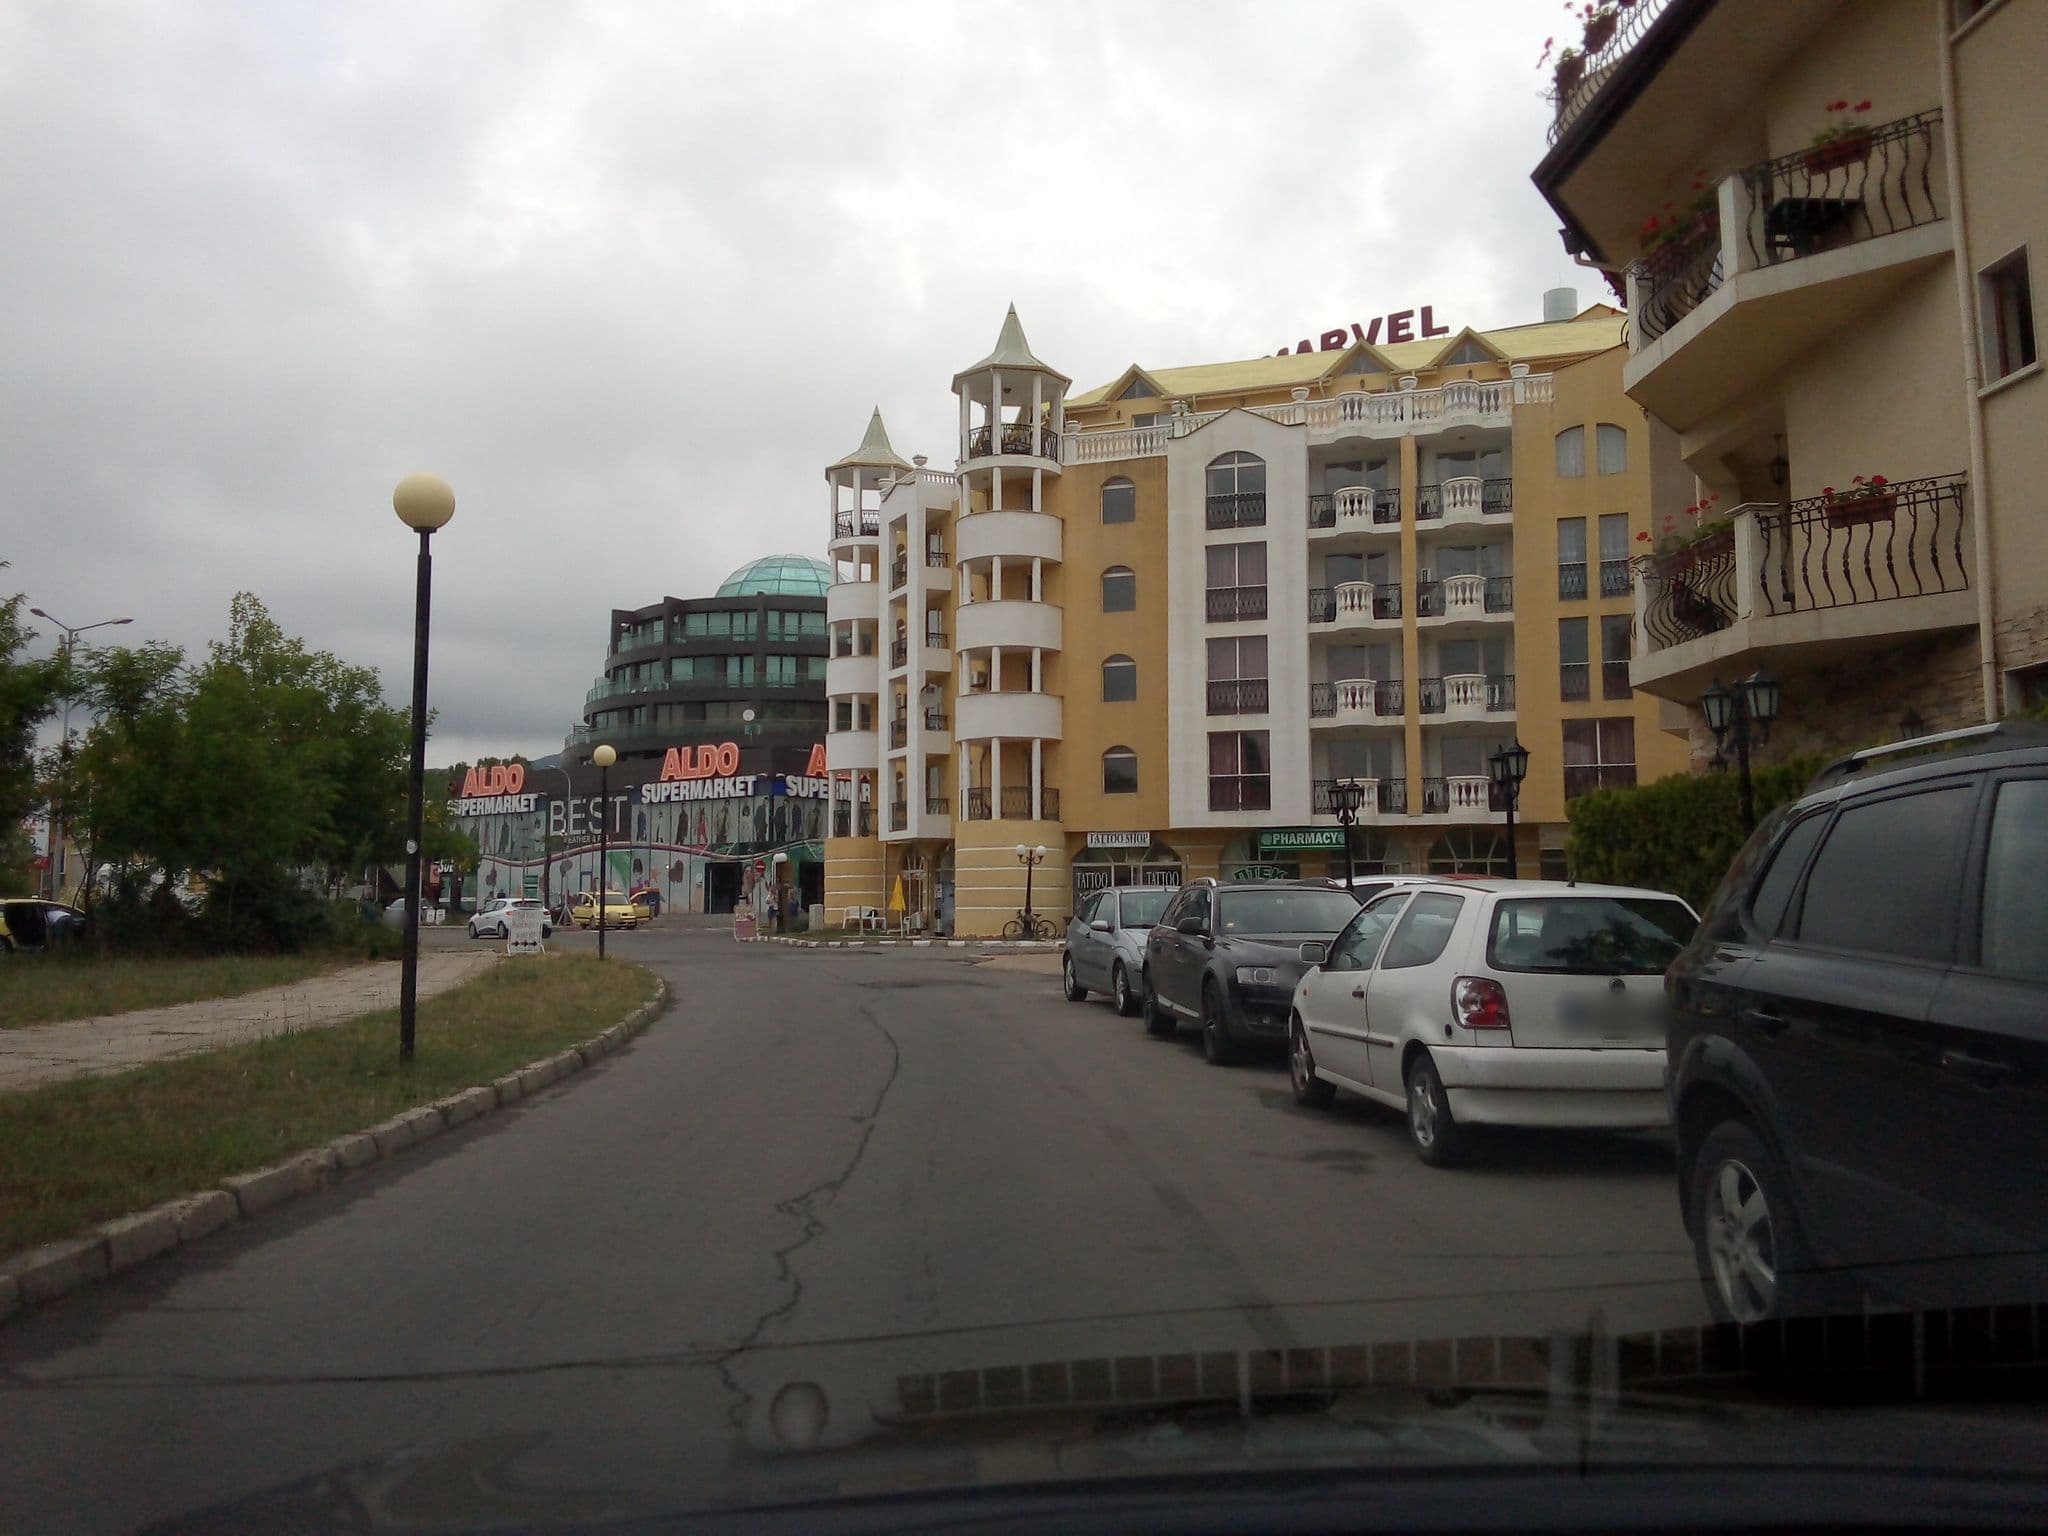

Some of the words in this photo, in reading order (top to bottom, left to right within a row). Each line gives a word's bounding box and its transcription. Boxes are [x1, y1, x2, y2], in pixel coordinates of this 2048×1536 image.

[660, 741, 739, 781] ALDO
[461, 763, 526, 799] ALDO
[641, 775, 757, 804] SUPERMARKET
[1090, 831, 1124, 845] TATTOO
[1125, 831, 1149, 845] SHOP
[1272, 831, 1339, 845] PHARMACY
[1076, 871, 1109, 889] TATTOO
[1146, 870, 1180, 887] TATTOO
